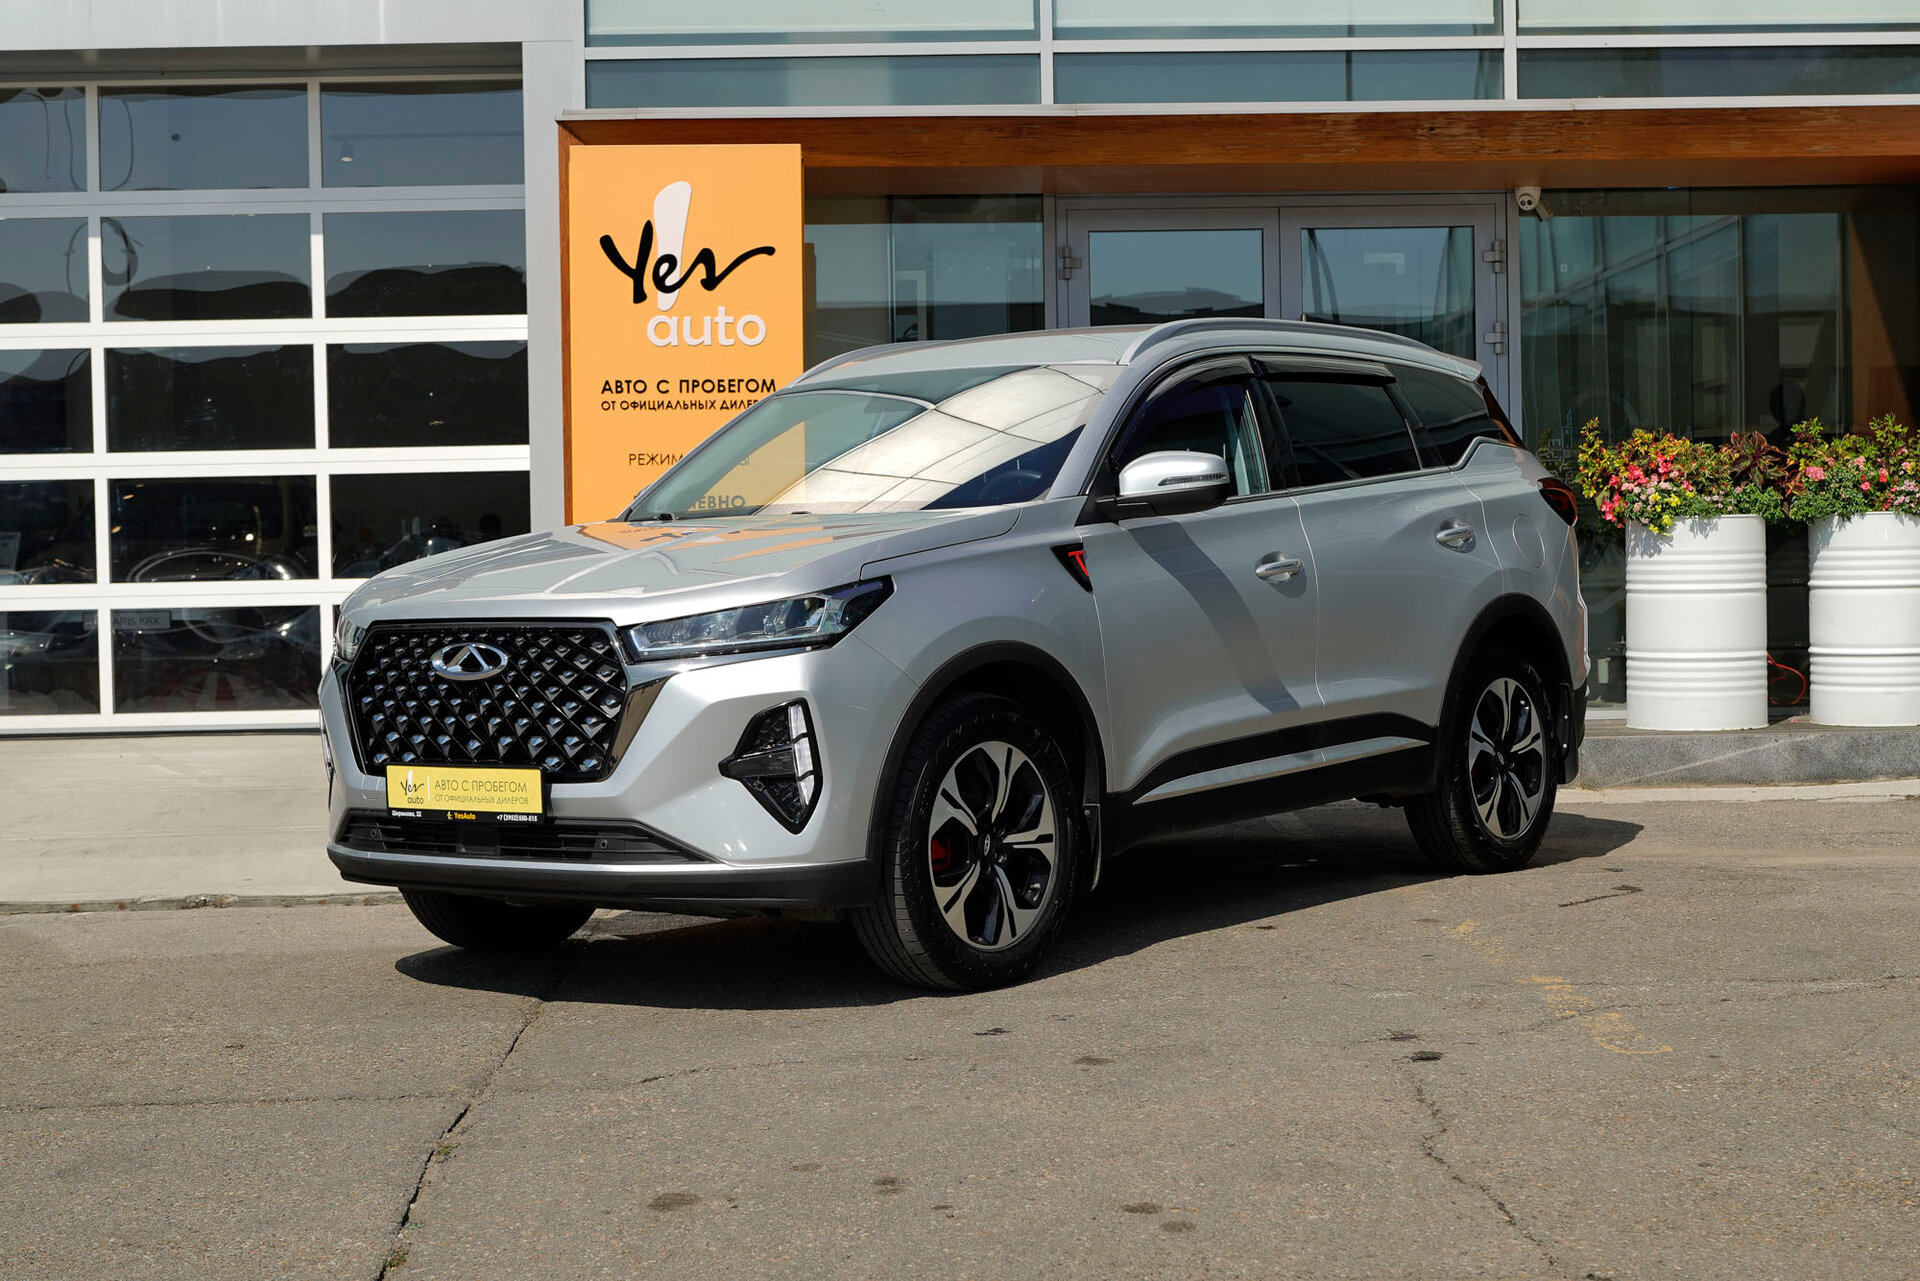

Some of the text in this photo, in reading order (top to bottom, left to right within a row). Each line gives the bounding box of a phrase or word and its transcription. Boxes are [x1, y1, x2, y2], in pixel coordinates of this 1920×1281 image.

[600, 219, 776, 304] Yes
[647, 305, 767, 347] auto
[601, 378, 777, 394] АВТО С ПРОБЕГОМ
[601, 399, 759, 411] ОТ ОФИЦИАЛЬНЫХ ДИЛЕ
[434, 779, 527, 793] АВТО С ПРОБЕГОМ
[407, 796, 424, 805] auto
[434, 795, 529, 805] ОТ ОФИЦИАЛЬНЫХ ДИЛЕРОВ
